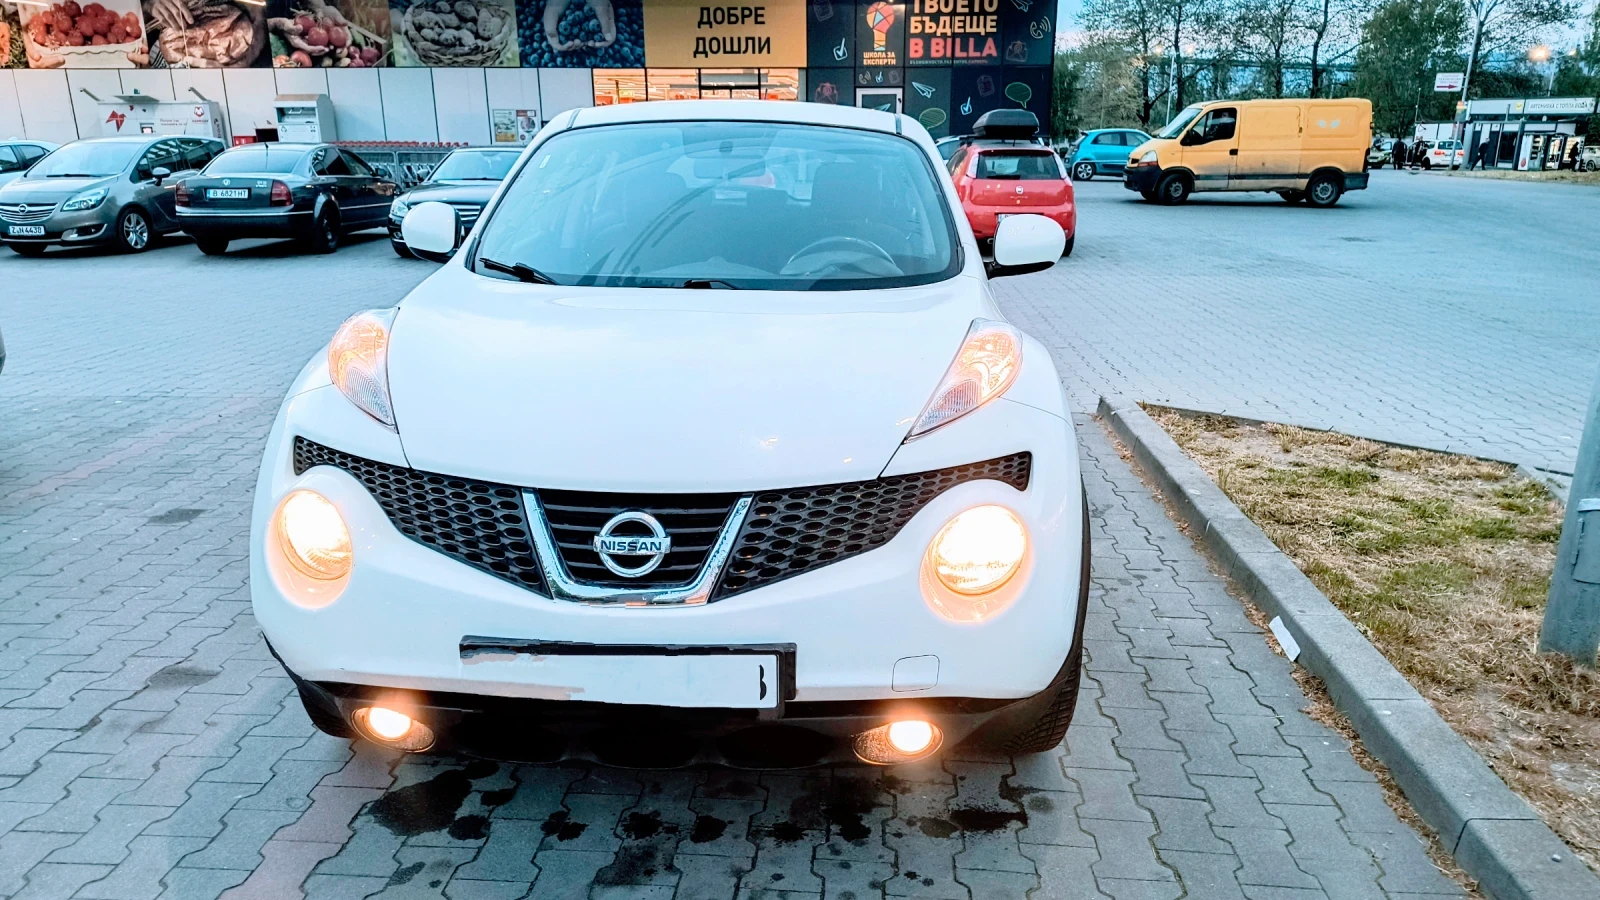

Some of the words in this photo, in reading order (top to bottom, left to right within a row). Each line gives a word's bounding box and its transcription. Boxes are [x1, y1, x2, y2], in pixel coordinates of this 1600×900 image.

[697, 6, 766, 29] ДОБРЕ
[913, 0, 998, 14] ТВОЕТО
[909, 15, 997, 37] БЪДЕЩЕ
[692, 36, 771, 59] ДОШЛИ
[930, 37, 998, 58] BILLA
[600, 540, 662, 551] NISSAN
